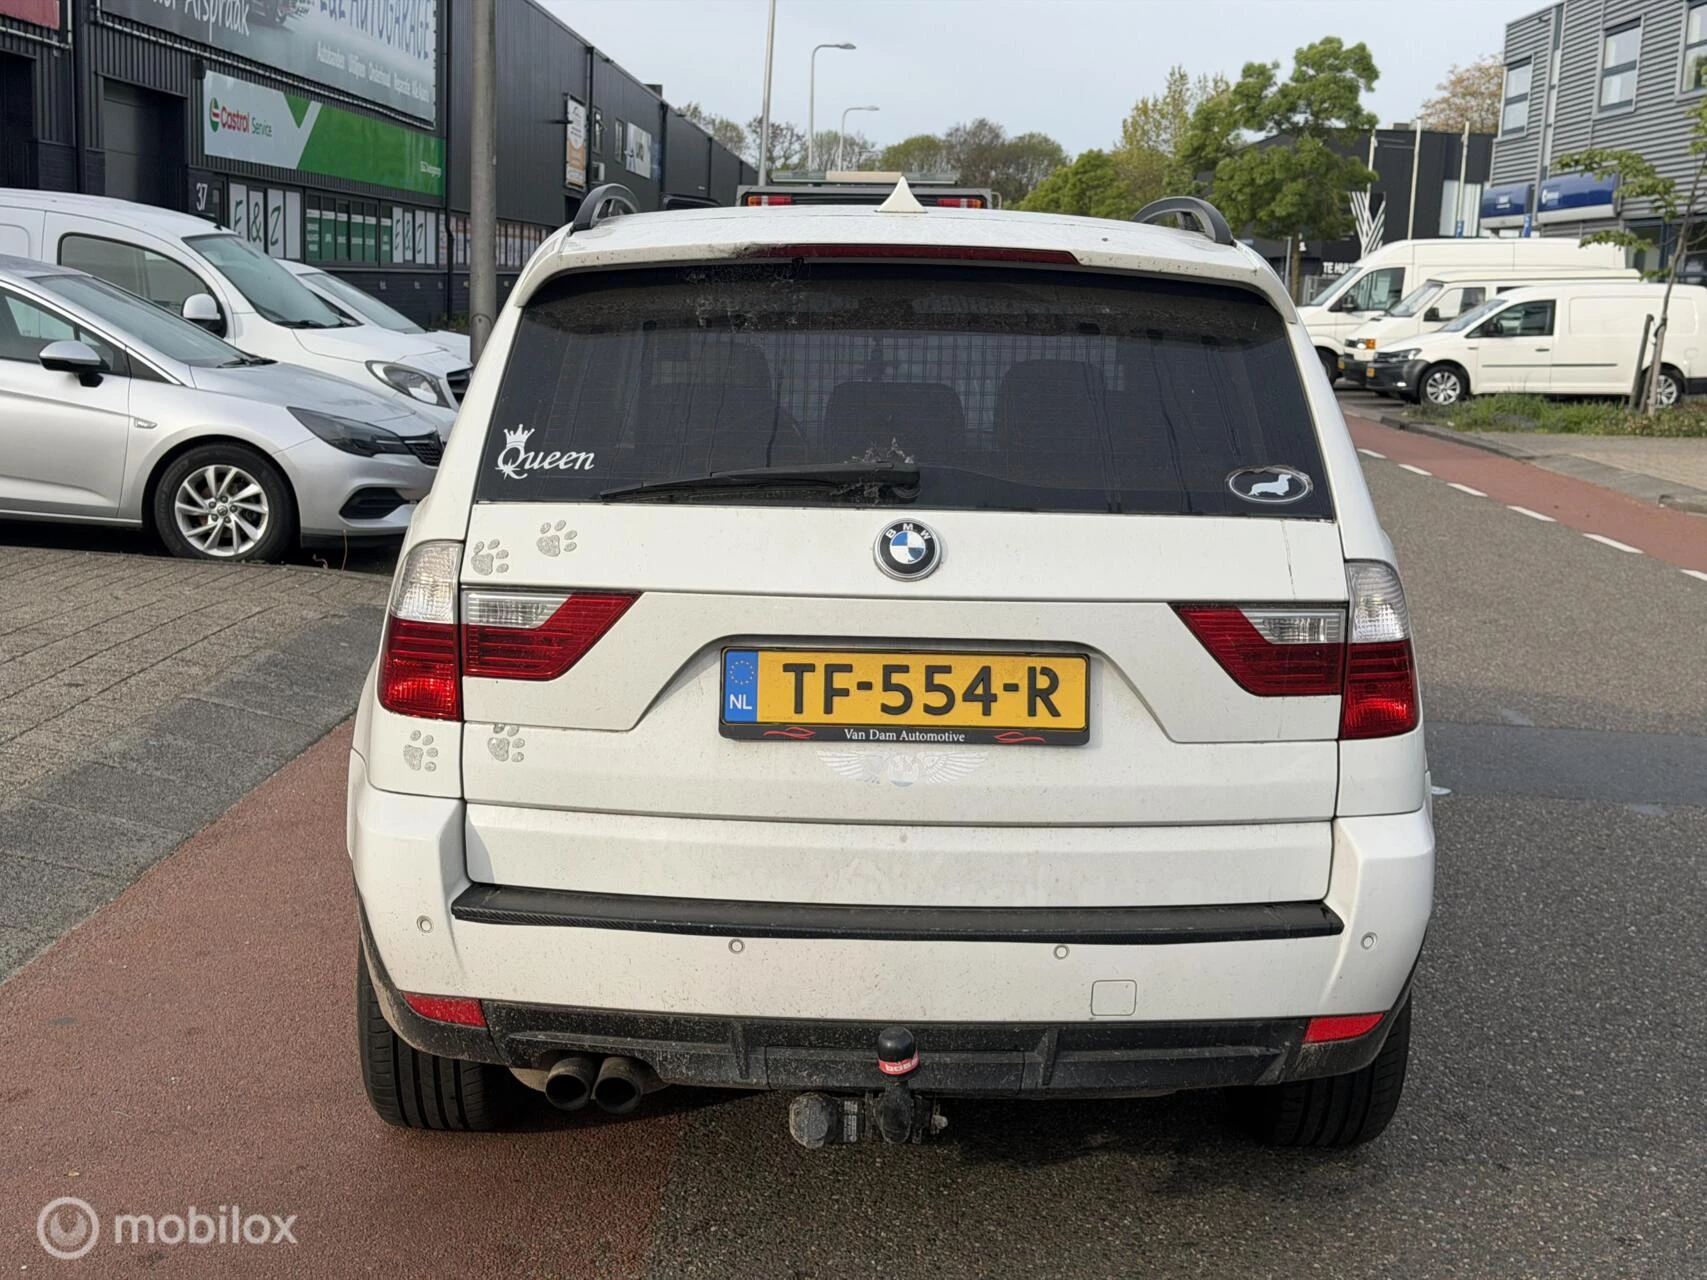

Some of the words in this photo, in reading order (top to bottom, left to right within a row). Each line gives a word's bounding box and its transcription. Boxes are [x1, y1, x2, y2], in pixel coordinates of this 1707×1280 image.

[220, 105, 250, 135] Castrol
[251, 116, 273, 138] Service
[196, 182, 209, 212] 37
[495, 446, 595, 480] Queen
[884, 522, 932, 541] BMW
[729, 693, 753, 711] NL
[782, 662, 1062, 718] TF-554-R
[844, 728, 866, 741] Van
[869, 729, 897, 742] Dam
[899, 729, 966, 743] Automotive
